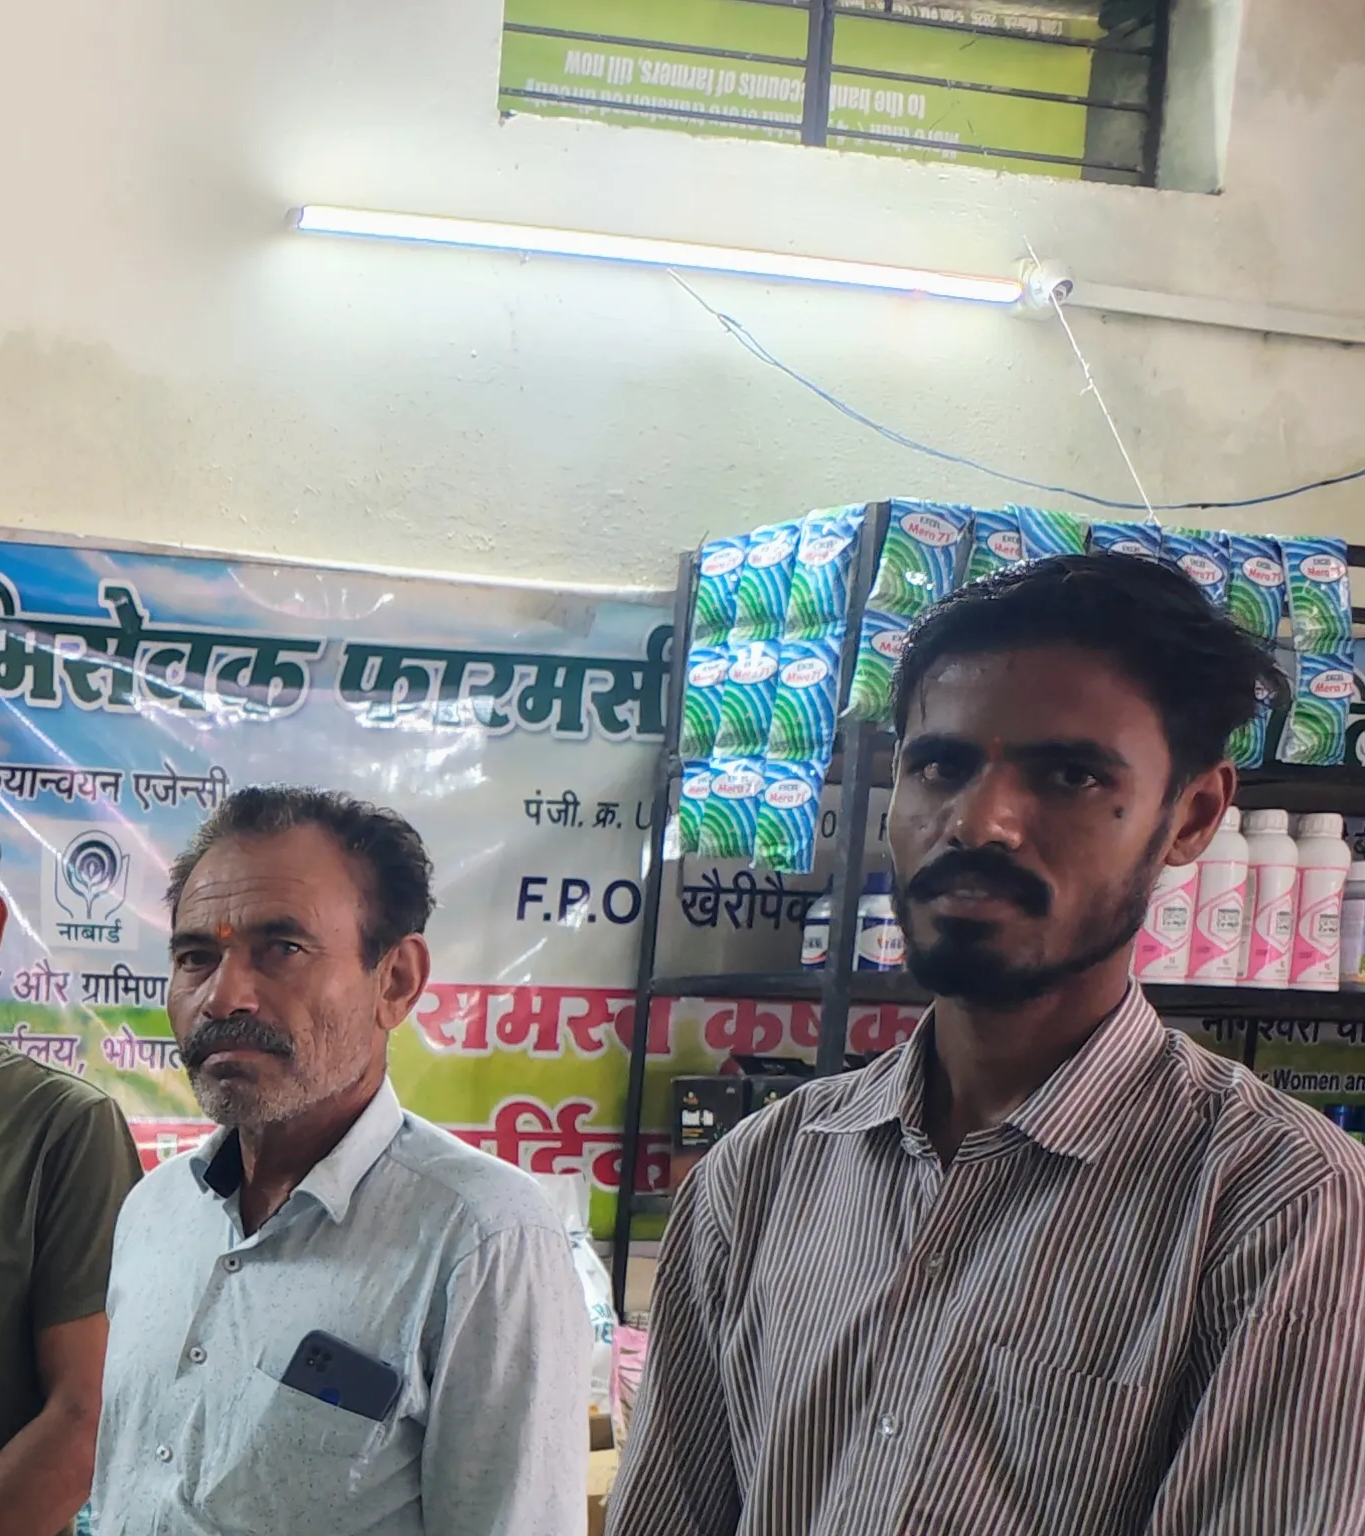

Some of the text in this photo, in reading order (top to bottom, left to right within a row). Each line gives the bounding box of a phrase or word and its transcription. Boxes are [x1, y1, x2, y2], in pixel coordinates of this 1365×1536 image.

[563, 50, 733, 97] of farmers, till now
[874, 91, 904, 118] the
[907, 94, 925, 120] to
[908, 522, 937, 542] Mera
[1248, 568, 1270, 581] Mera
[1315, 684, 1337, 694] Mera
[132, 760, 231, 810] एजेन्सी
[55, 918, 124, 944] नाबार्ड
[12, 958, 70, 1002] और
[1272, 1067, 1365, 1091] Women an
